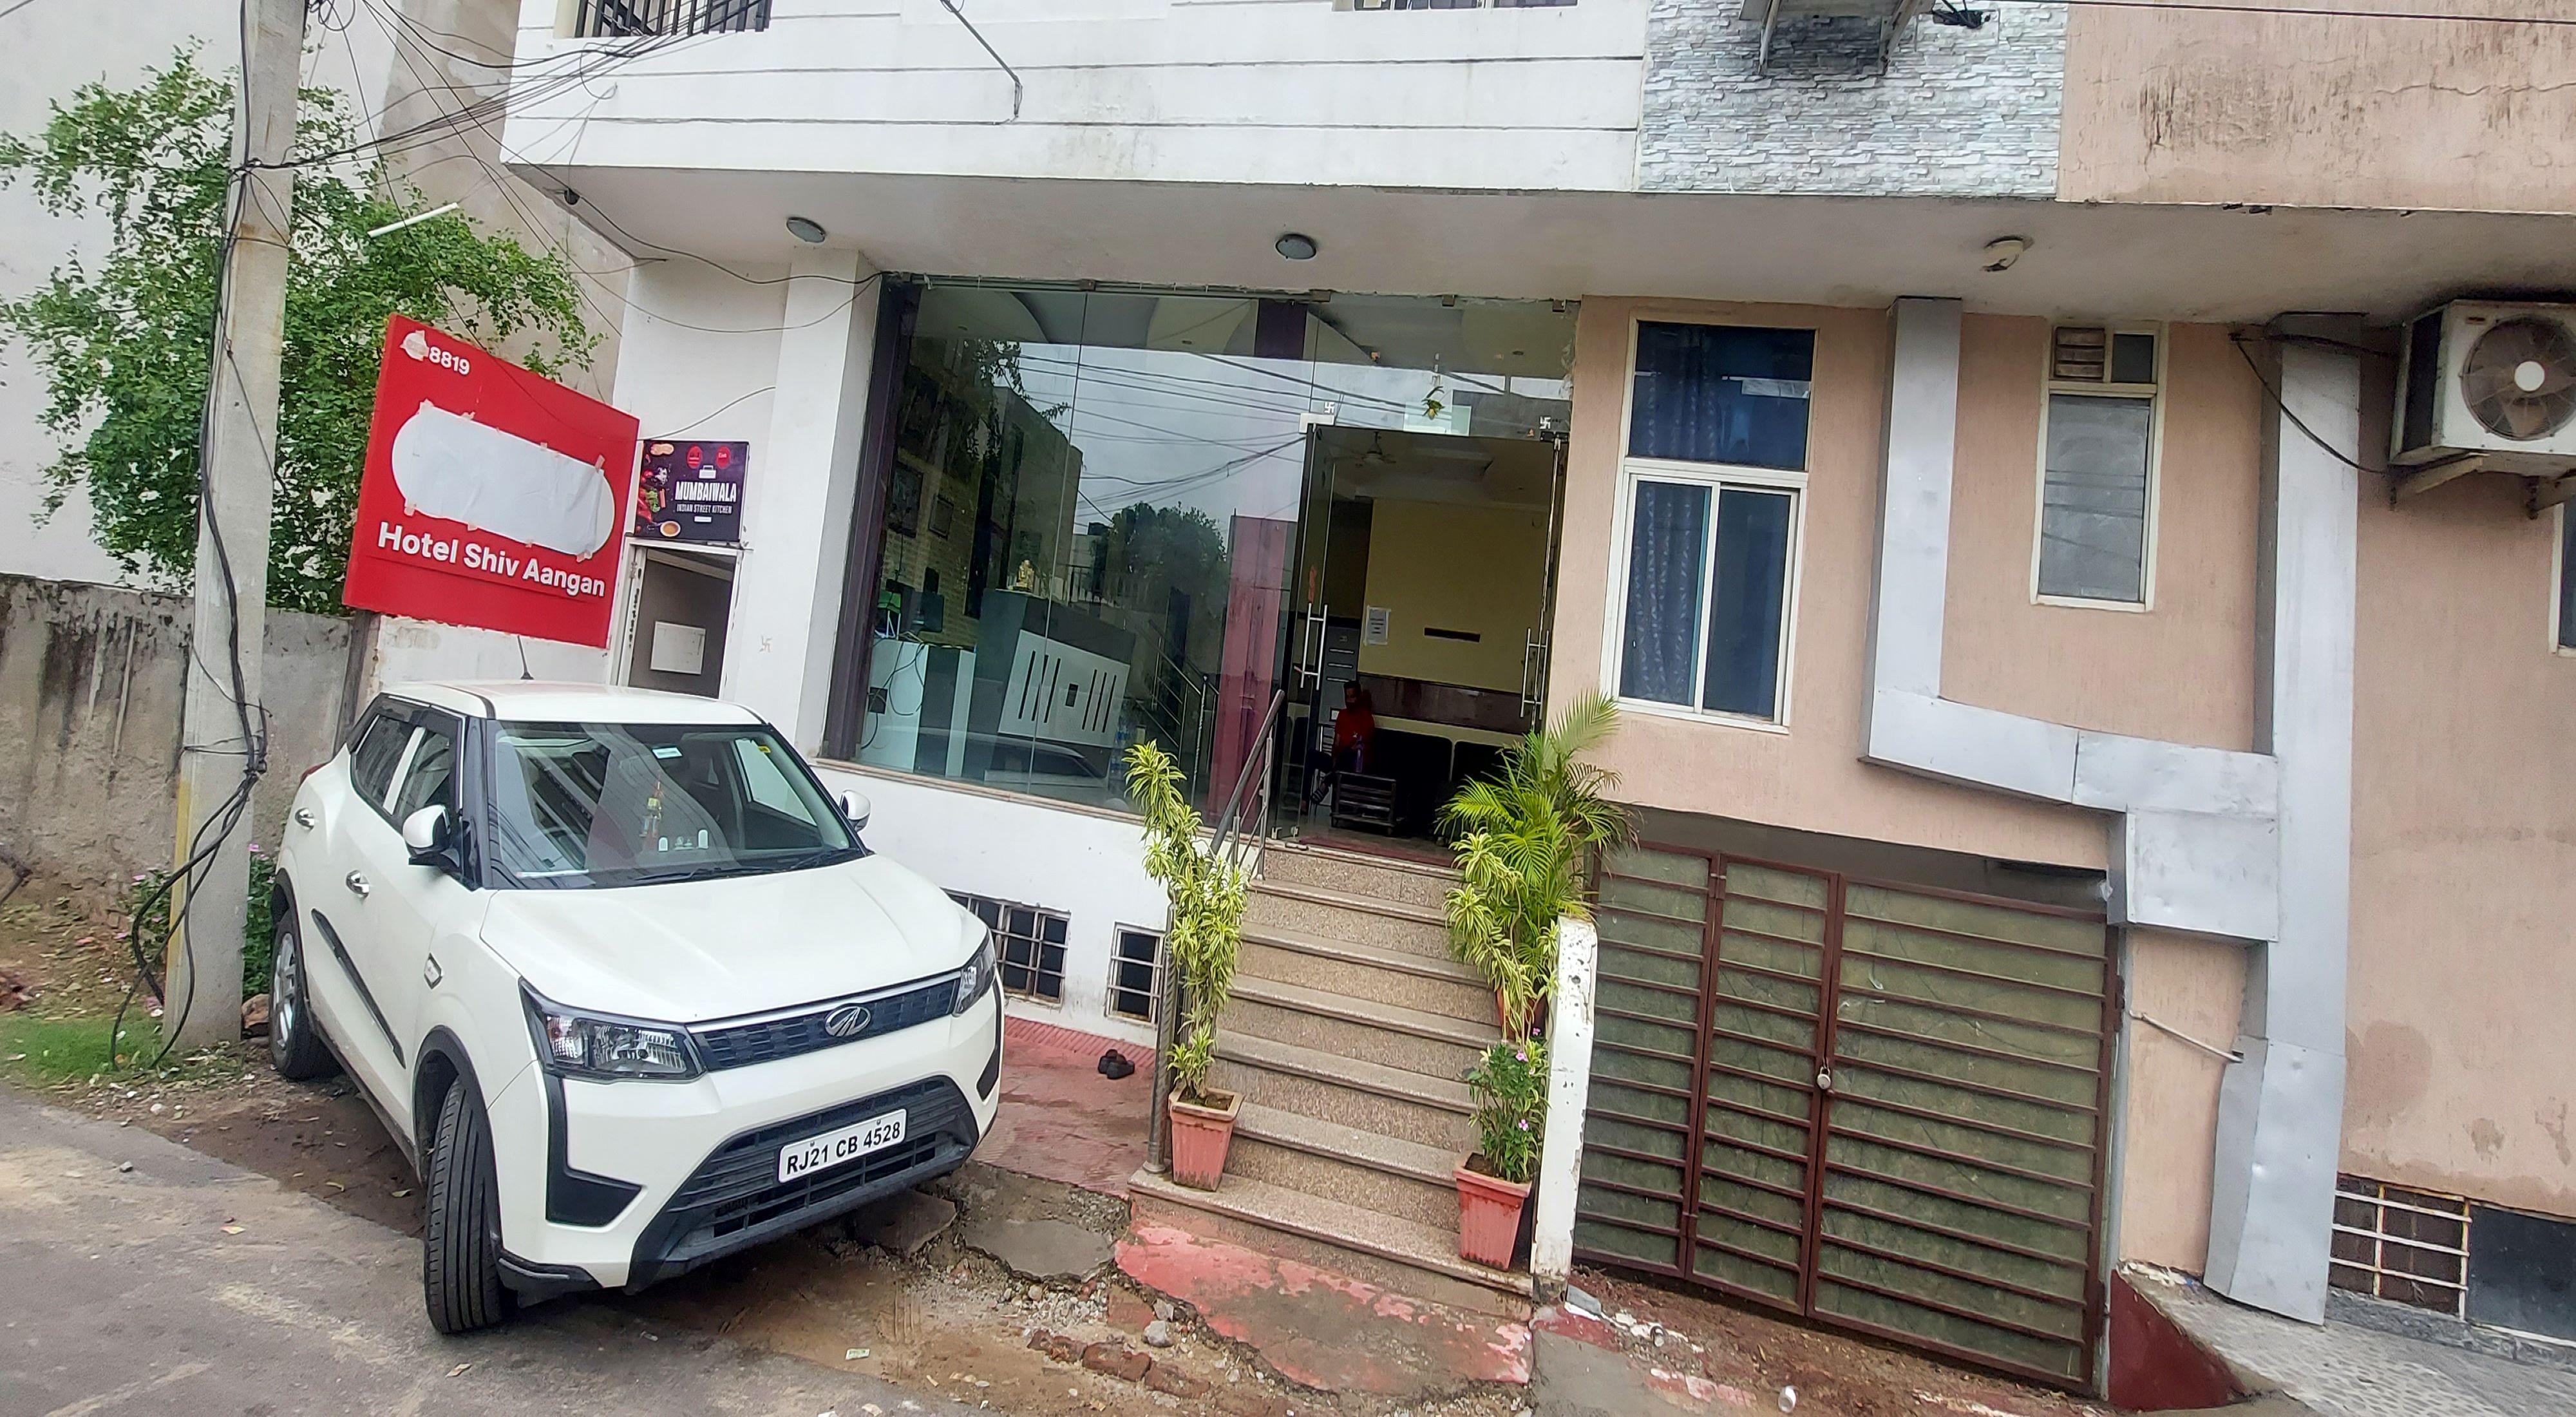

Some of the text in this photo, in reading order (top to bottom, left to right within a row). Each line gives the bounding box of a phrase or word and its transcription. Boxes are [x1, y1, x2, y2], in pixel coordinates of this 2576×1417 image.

[429, 346, 470, 375] 8819
[675, 481, 737, 502] MUMBAIWALA
[676, 504, 732, 514] INDIAN STREET KITCHEN
[377, 521, 605, 597] Hotel Shiv Aangan
[786, 1121, 900, 1175] RJ21 CB 4528
